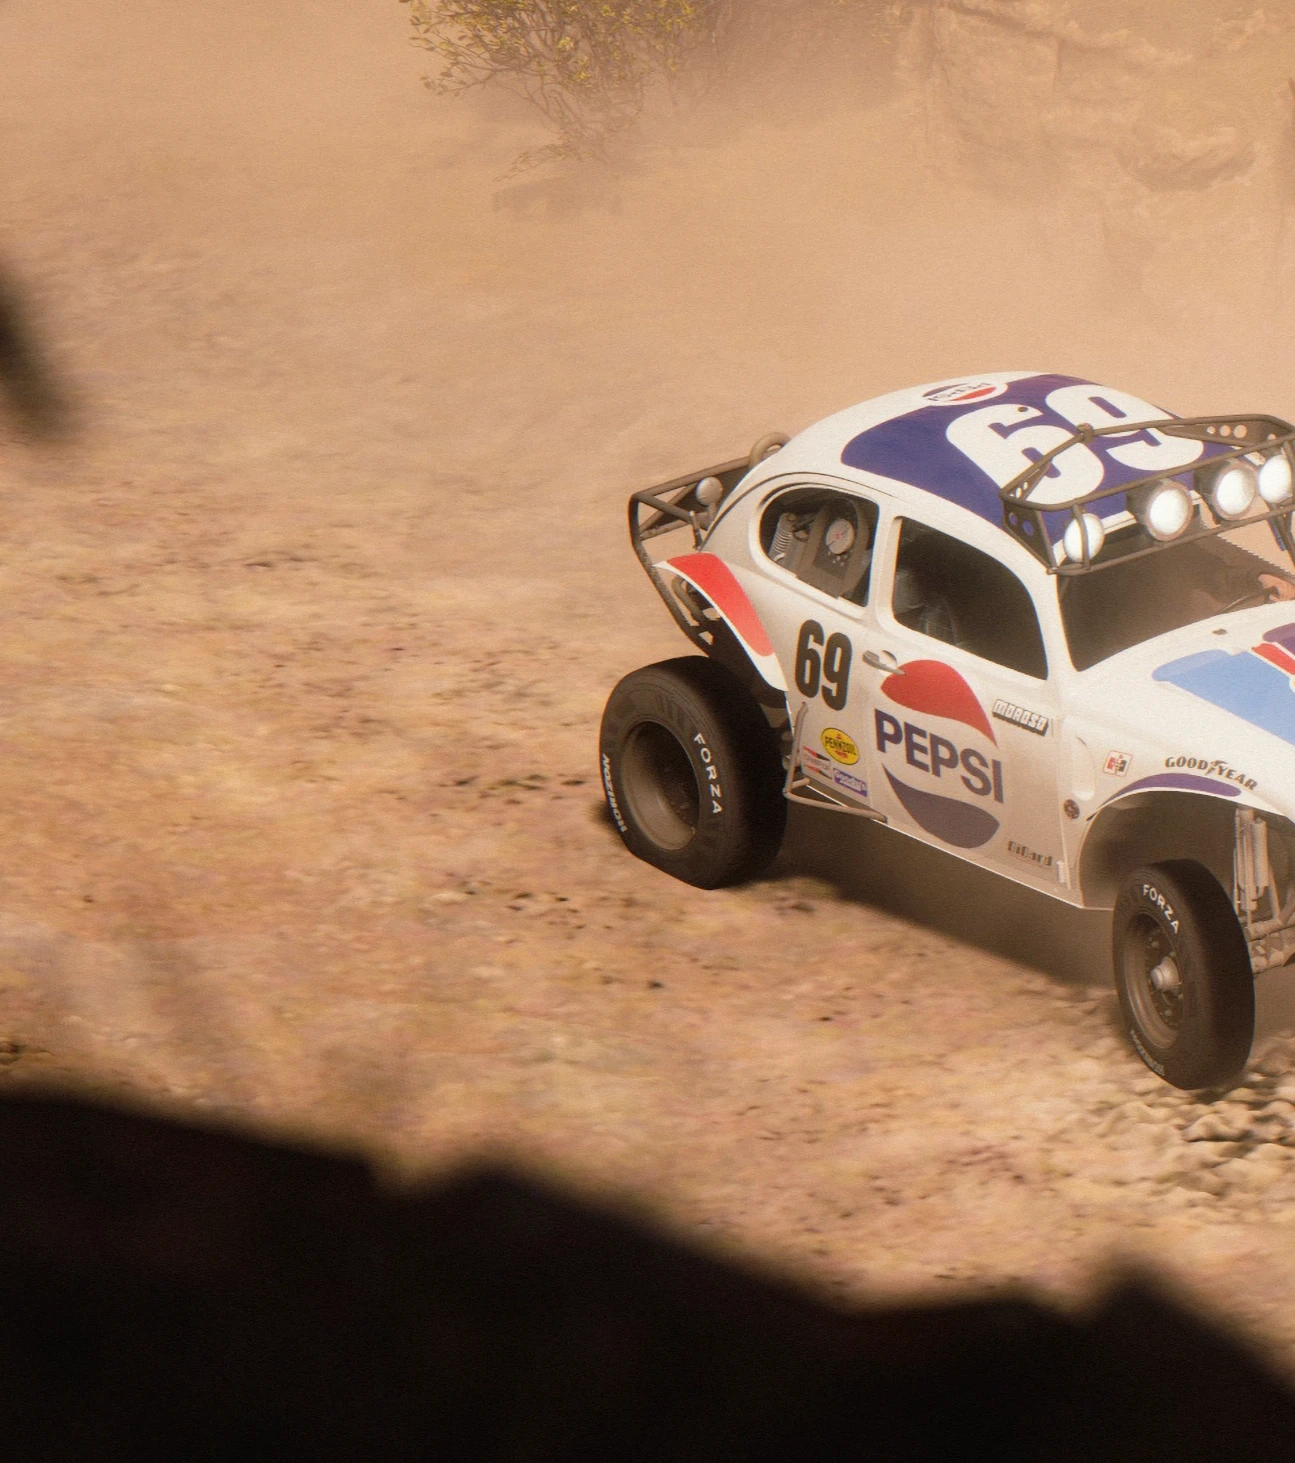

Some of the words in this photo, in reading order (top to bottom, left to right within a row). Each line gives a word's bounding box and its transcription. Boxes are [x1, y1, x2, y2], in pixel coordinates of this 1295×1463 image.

[946, 384, 1204, 505] 69
[795, 619, 853, 711] 69
[874, 708, 1004, 804] PEPSI
[992, 699, 1049, 737] MOROSO
[693, 732, 723, 814] FORZA
[1164, 755, 1258, 790] GOODYEAR
[1142, 884, 1180, 934] FORZA
